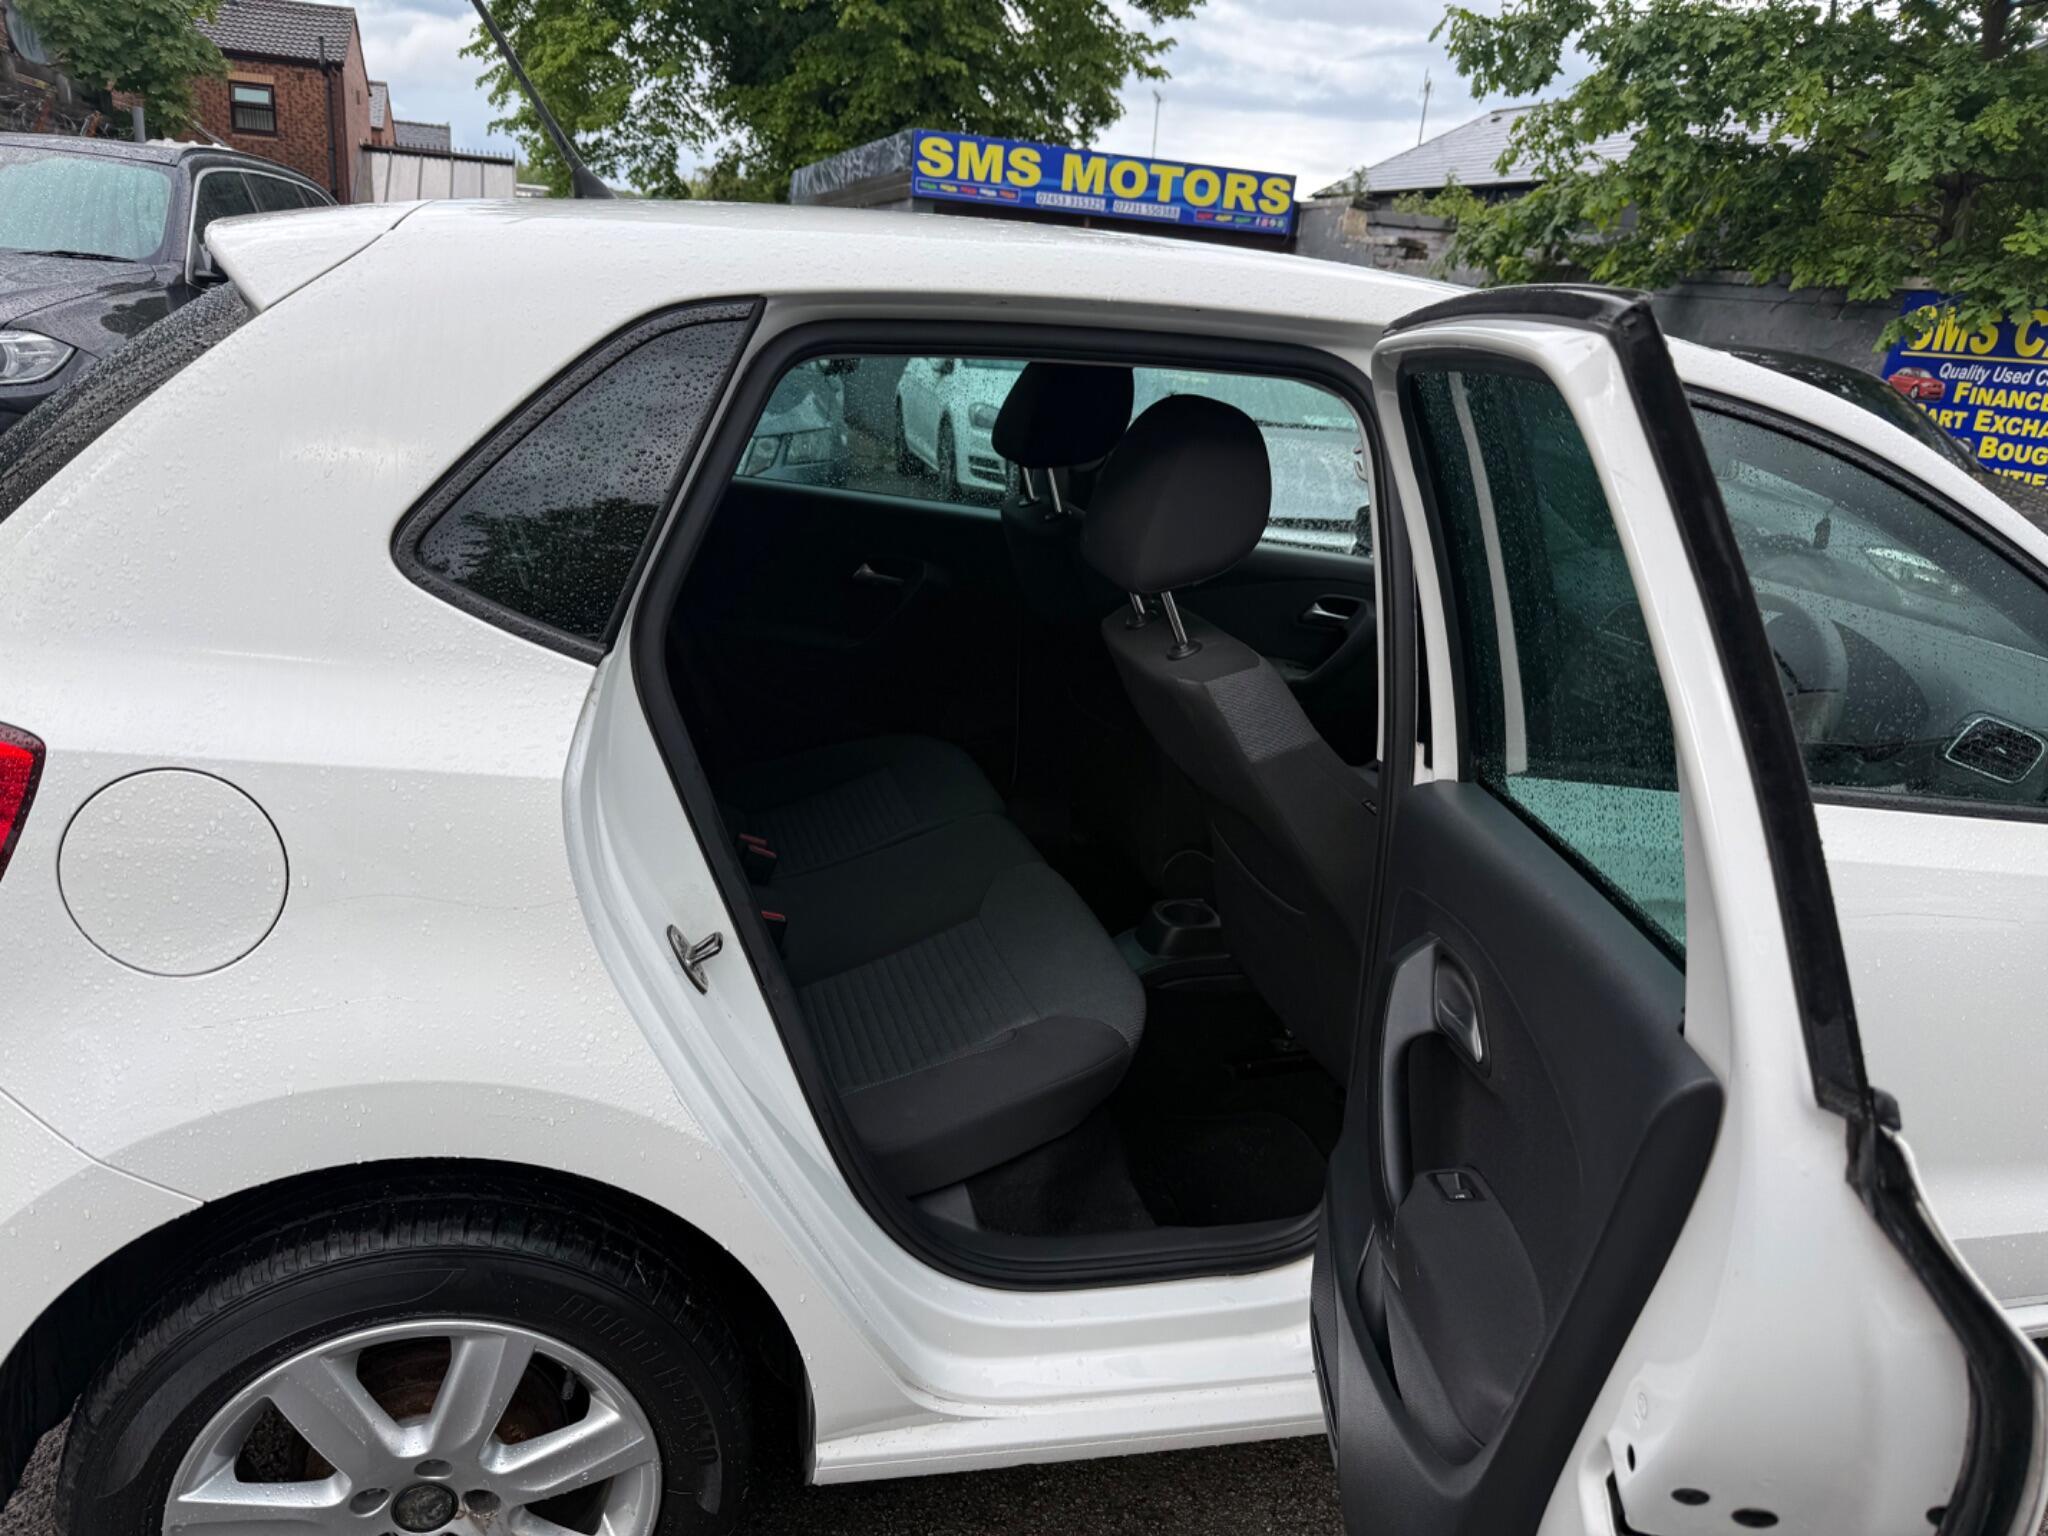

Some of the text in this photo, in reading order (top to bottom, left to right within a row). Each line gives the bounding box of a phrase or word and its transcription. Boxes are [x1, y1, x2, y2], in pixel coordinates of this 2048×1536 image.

[917, 137, 1292, 214] SMS MOTORS
[2015, 309, 2048, 357] C
[1939, 363, 2048, 387] Quality Used C
